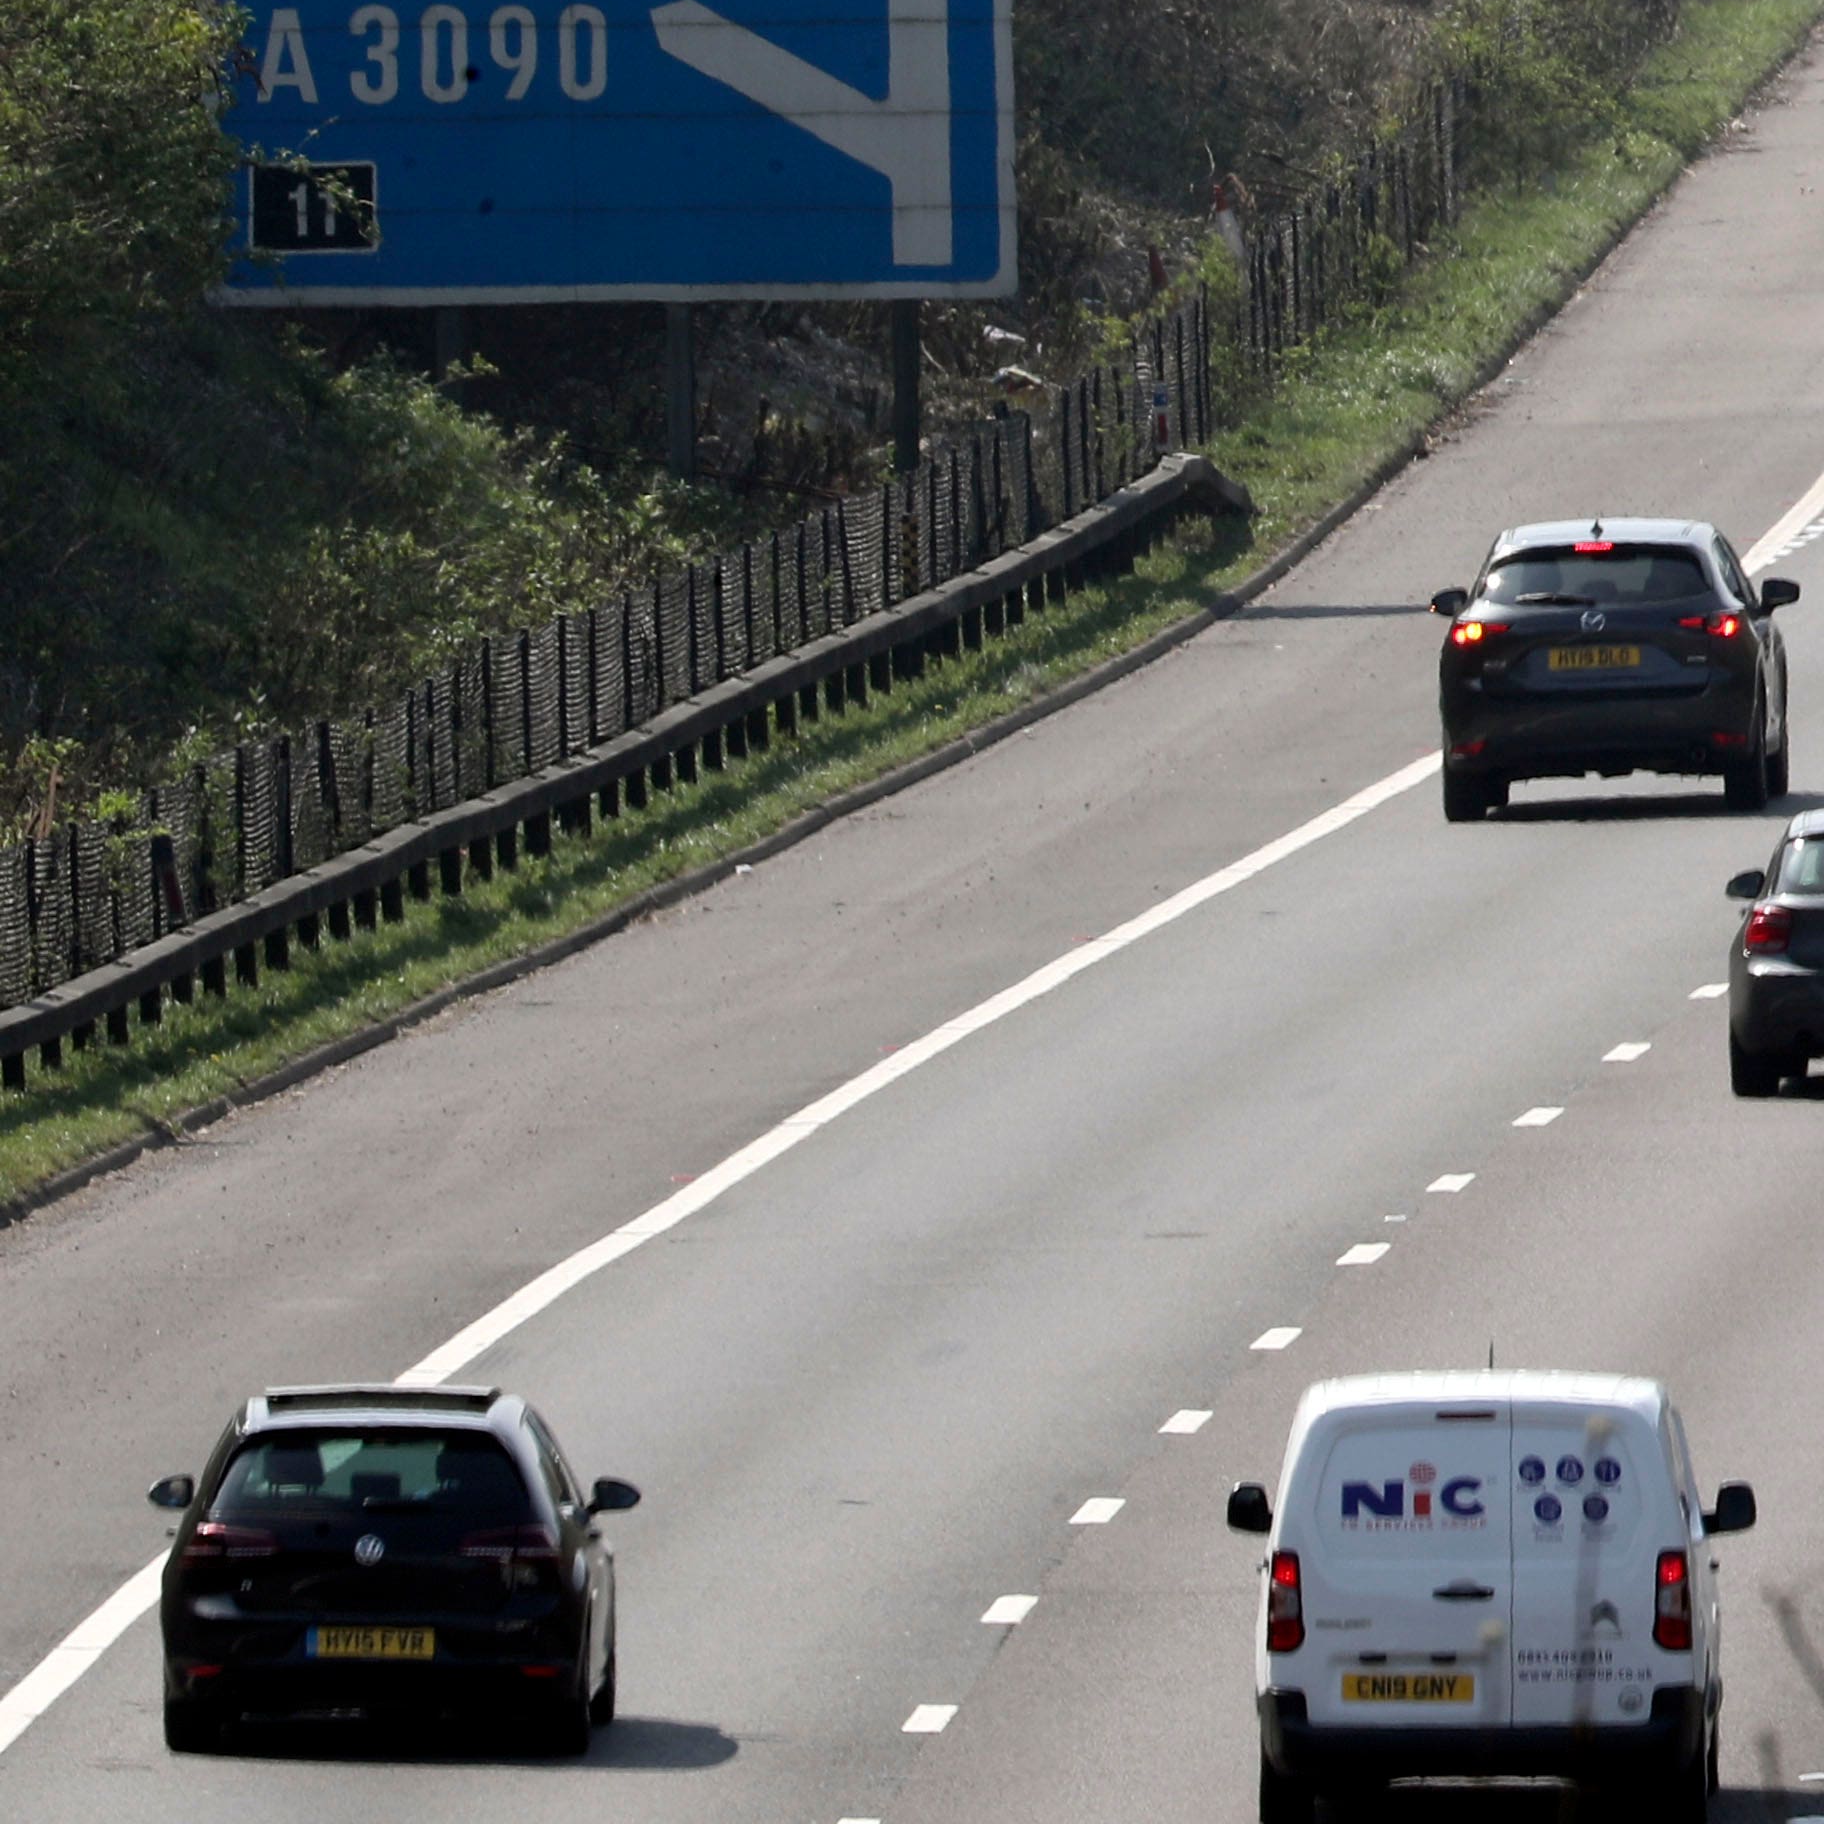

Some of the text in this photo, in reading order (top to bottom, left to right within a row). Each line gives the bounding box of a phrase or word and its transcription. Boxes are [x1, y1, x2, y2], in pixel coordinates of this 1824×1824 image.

[349, 3, 609, 105] 3090
[288, 183, 338, 238] 11
[1356, 1676, 1406, 1702] CN19
